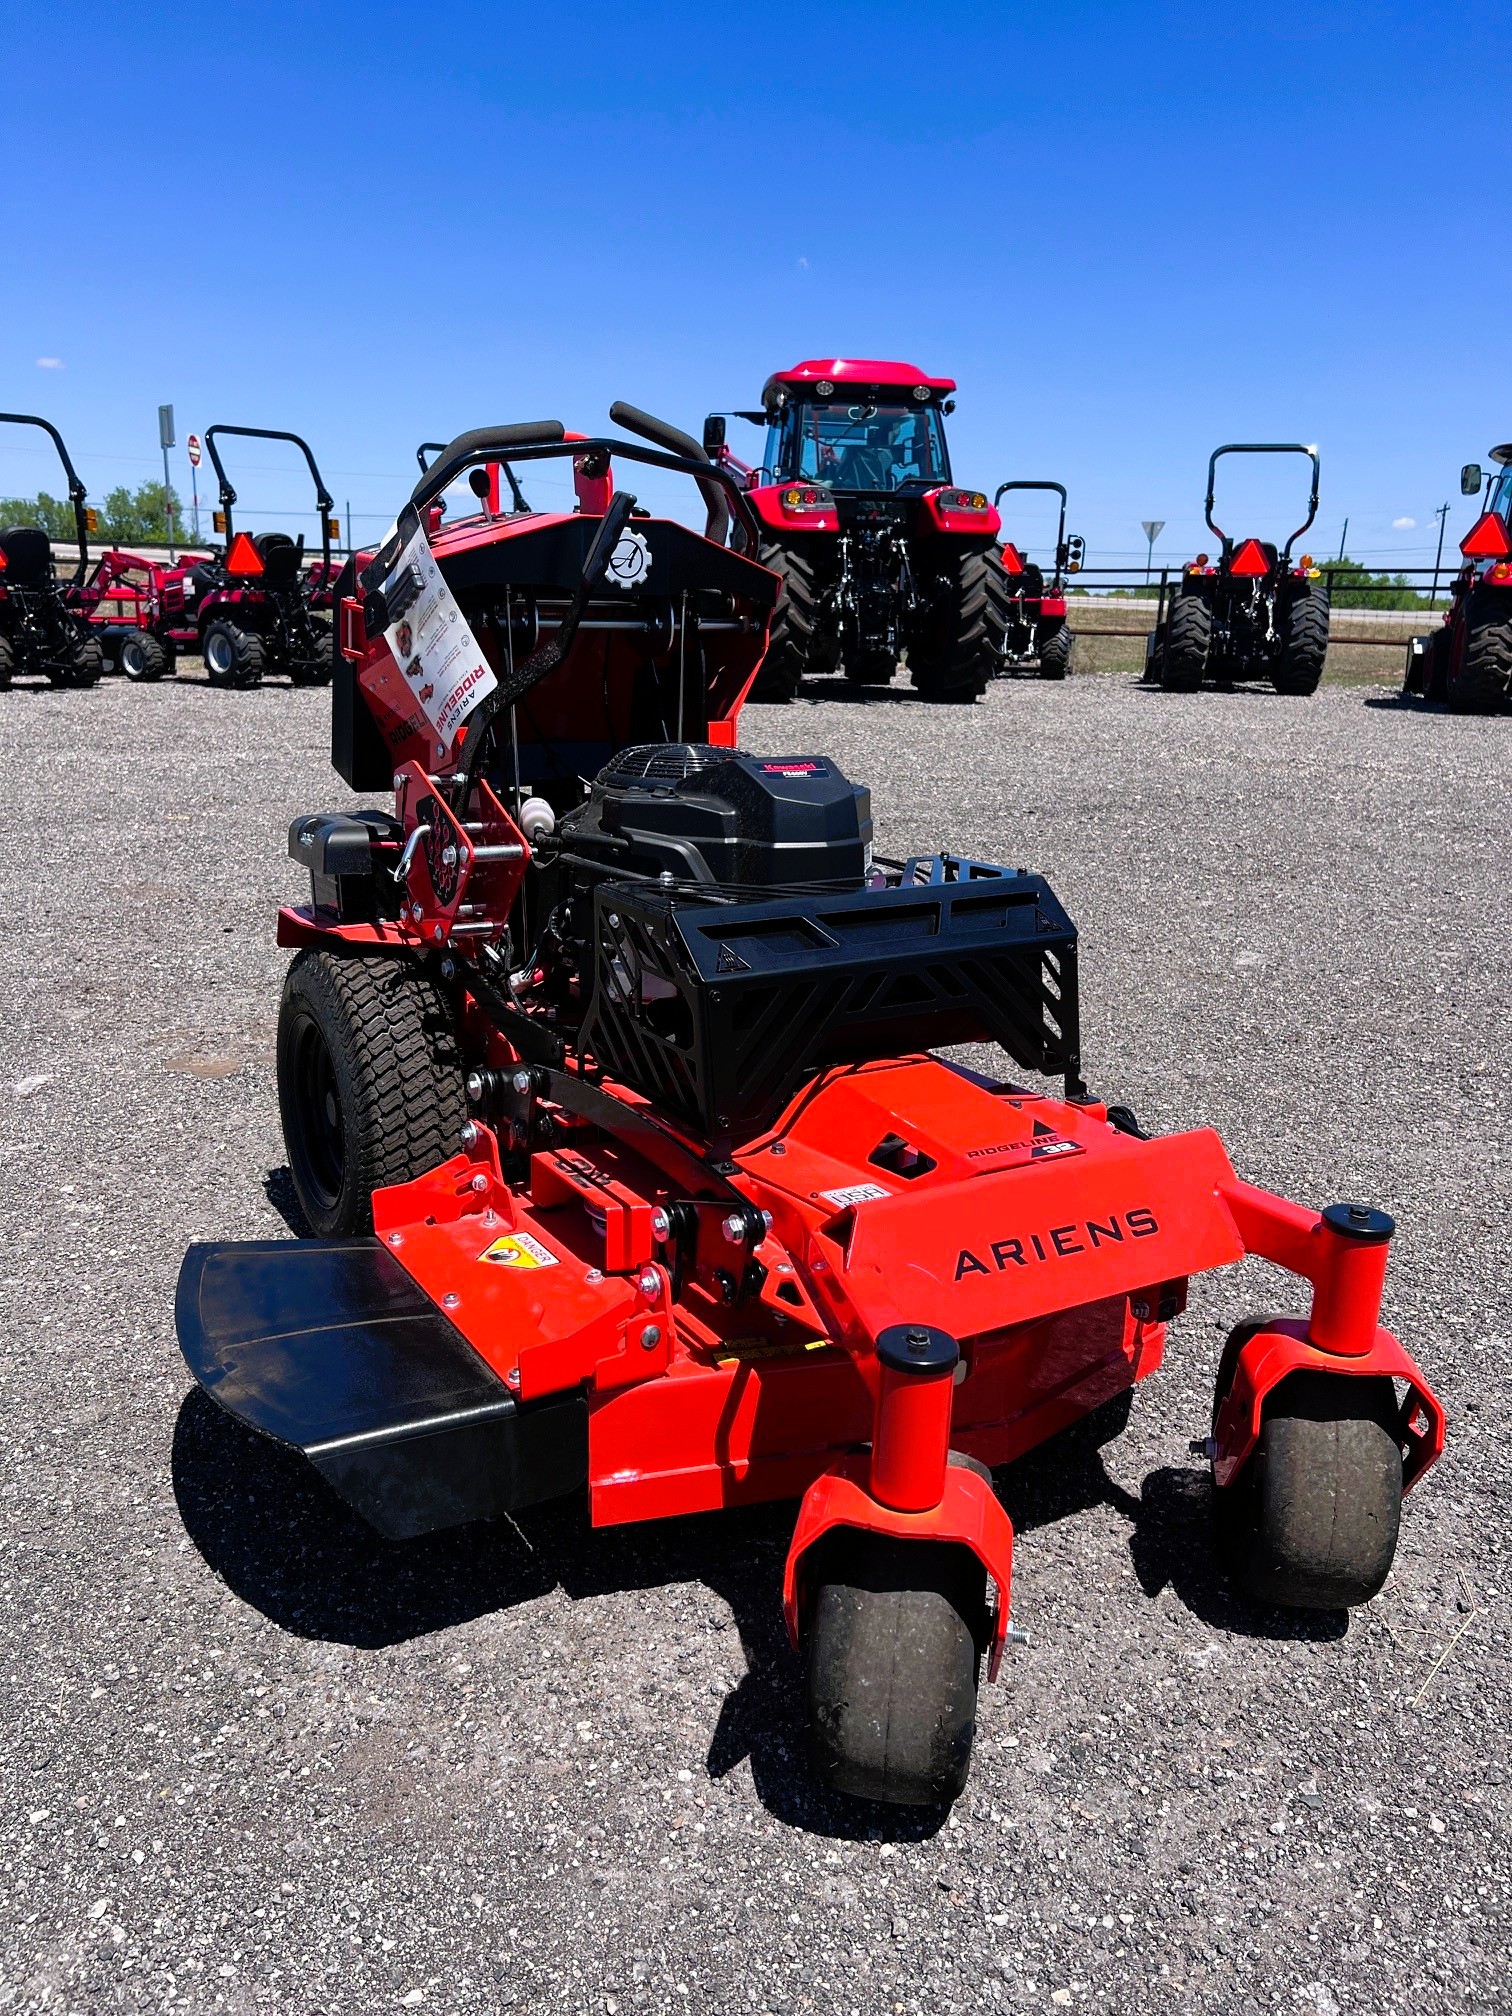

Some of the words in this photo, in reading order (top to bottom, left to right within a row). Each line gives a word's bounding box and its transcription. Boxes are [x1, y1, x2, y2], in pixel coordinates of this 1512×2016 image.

[436, 664, 486, 733] RIDGELINE
[447, 689, 475, 730] ARIENS
[388, 711, 428, 746] RIDGELI
[764, 762, 816, 771] Kawasaki
[967, 1135, 1060, 1158] RIDGELINE
[1042, 1143, 1076, 1154] 32
[831, 1188, 885, 1203] USA
[517, 1236, 551, 1263] DANGER
[954, 1208, 1158, 1281] ARIENS
